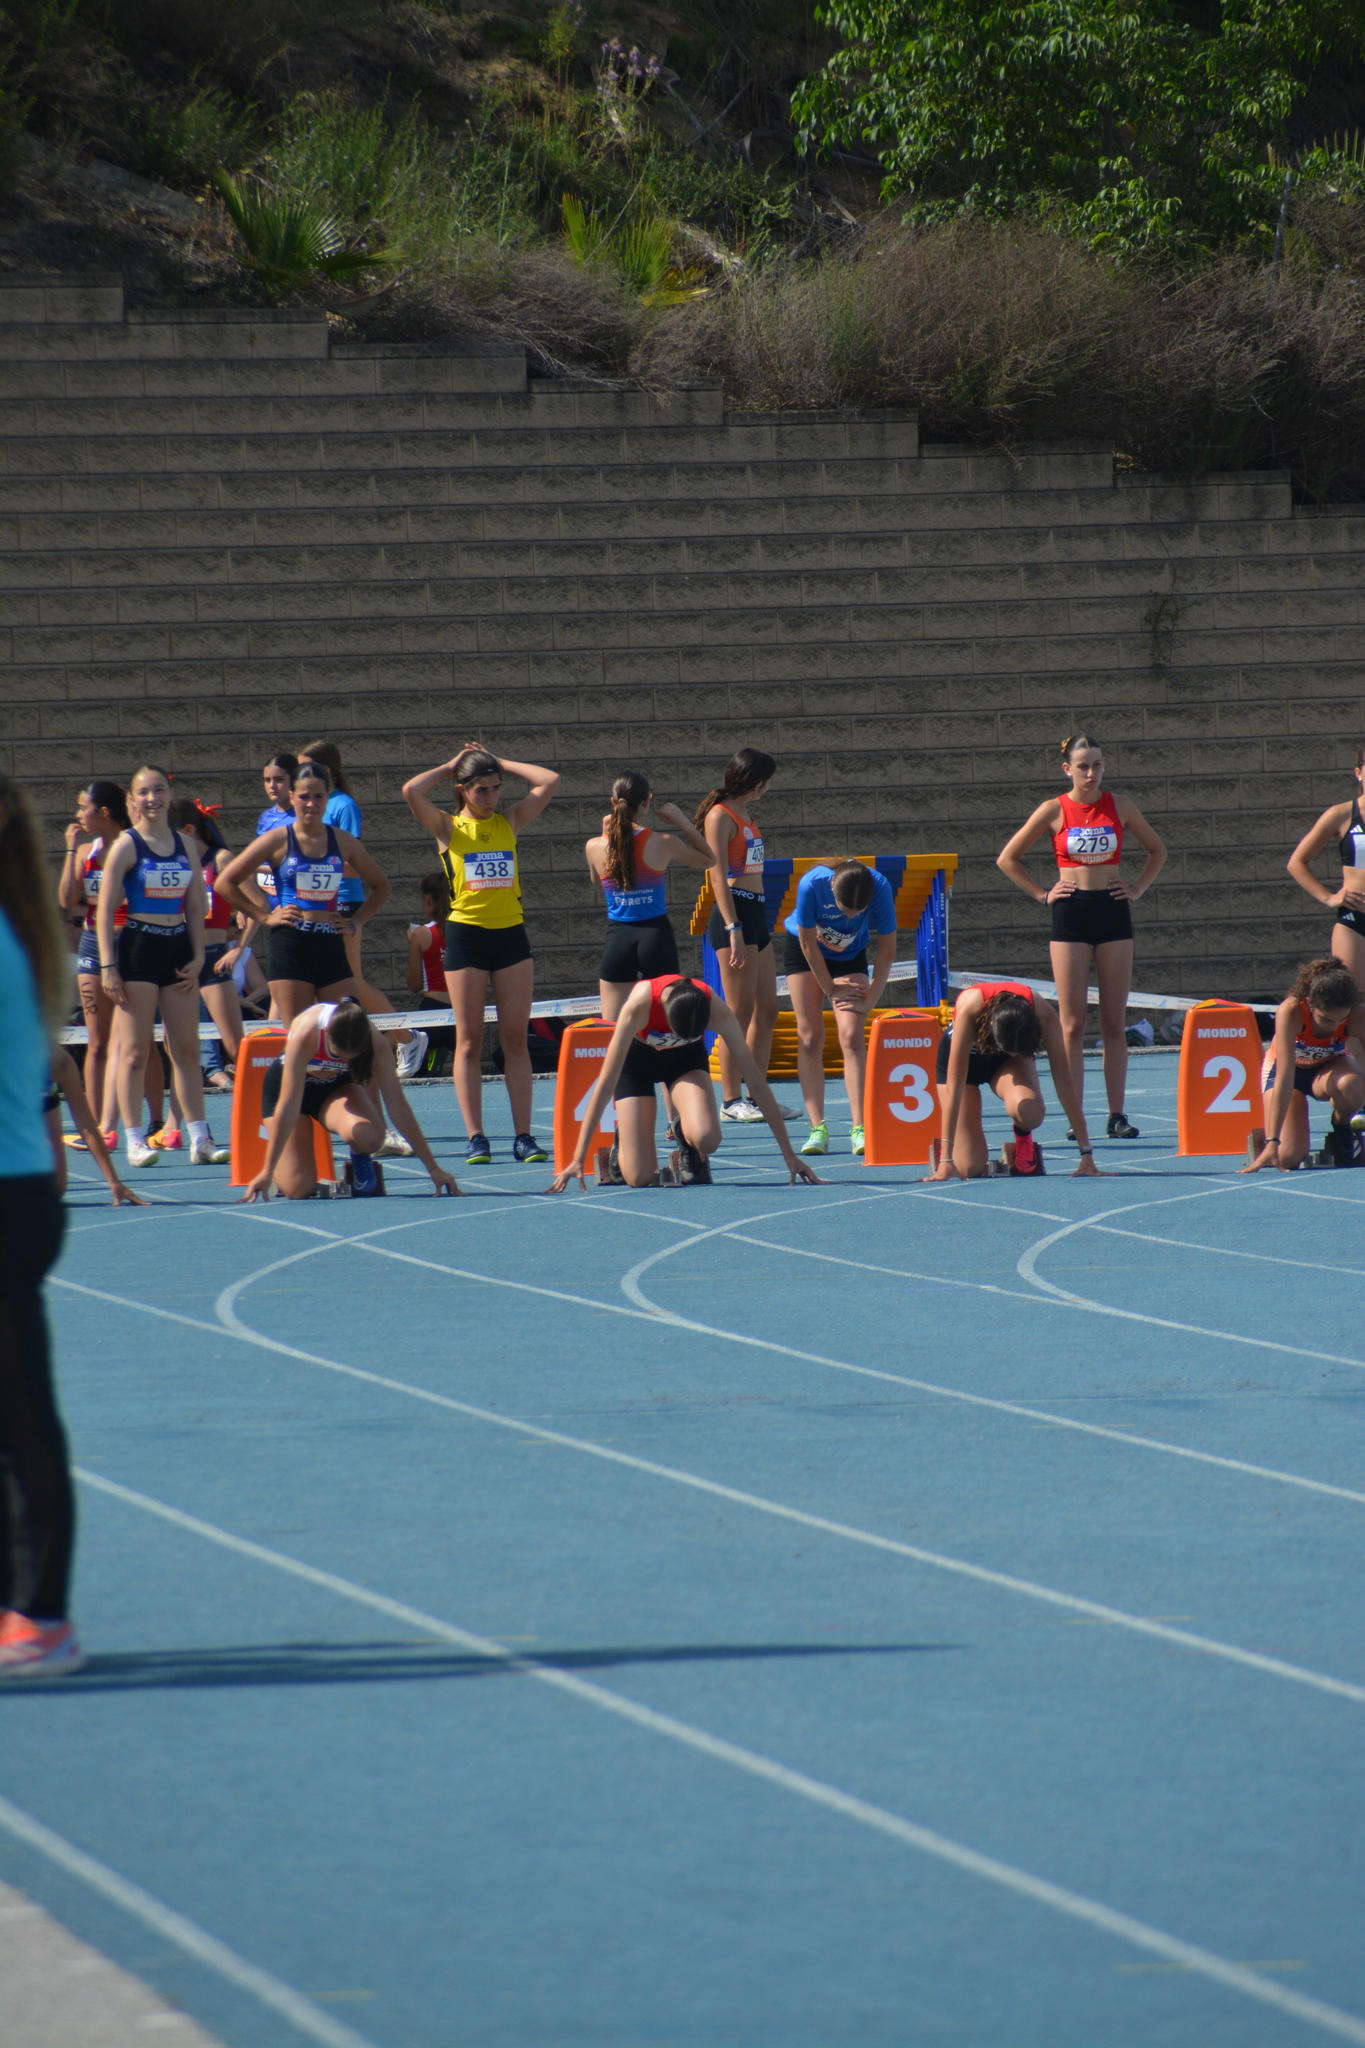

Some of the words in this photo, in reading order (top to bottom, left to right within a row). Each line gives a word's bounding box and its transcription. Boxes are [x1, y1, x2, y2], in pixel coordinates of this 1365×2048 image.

[1077, 836, 1109, 853] 279
[474, 861, 509, 878] 438
[161, 871, 180, 887] 65
[311, 874, 332, 889] 57
[141, 924, 173, 936] NIKE
[1198, 1027, 1247, 1038] MONDO
[883, 1037, 932, 1049] MONDO
[574, 1047, 608, 1058] MON
[1203, 1055, 1251, 1113] 2
[888, 1063, 935, 1123] 3
